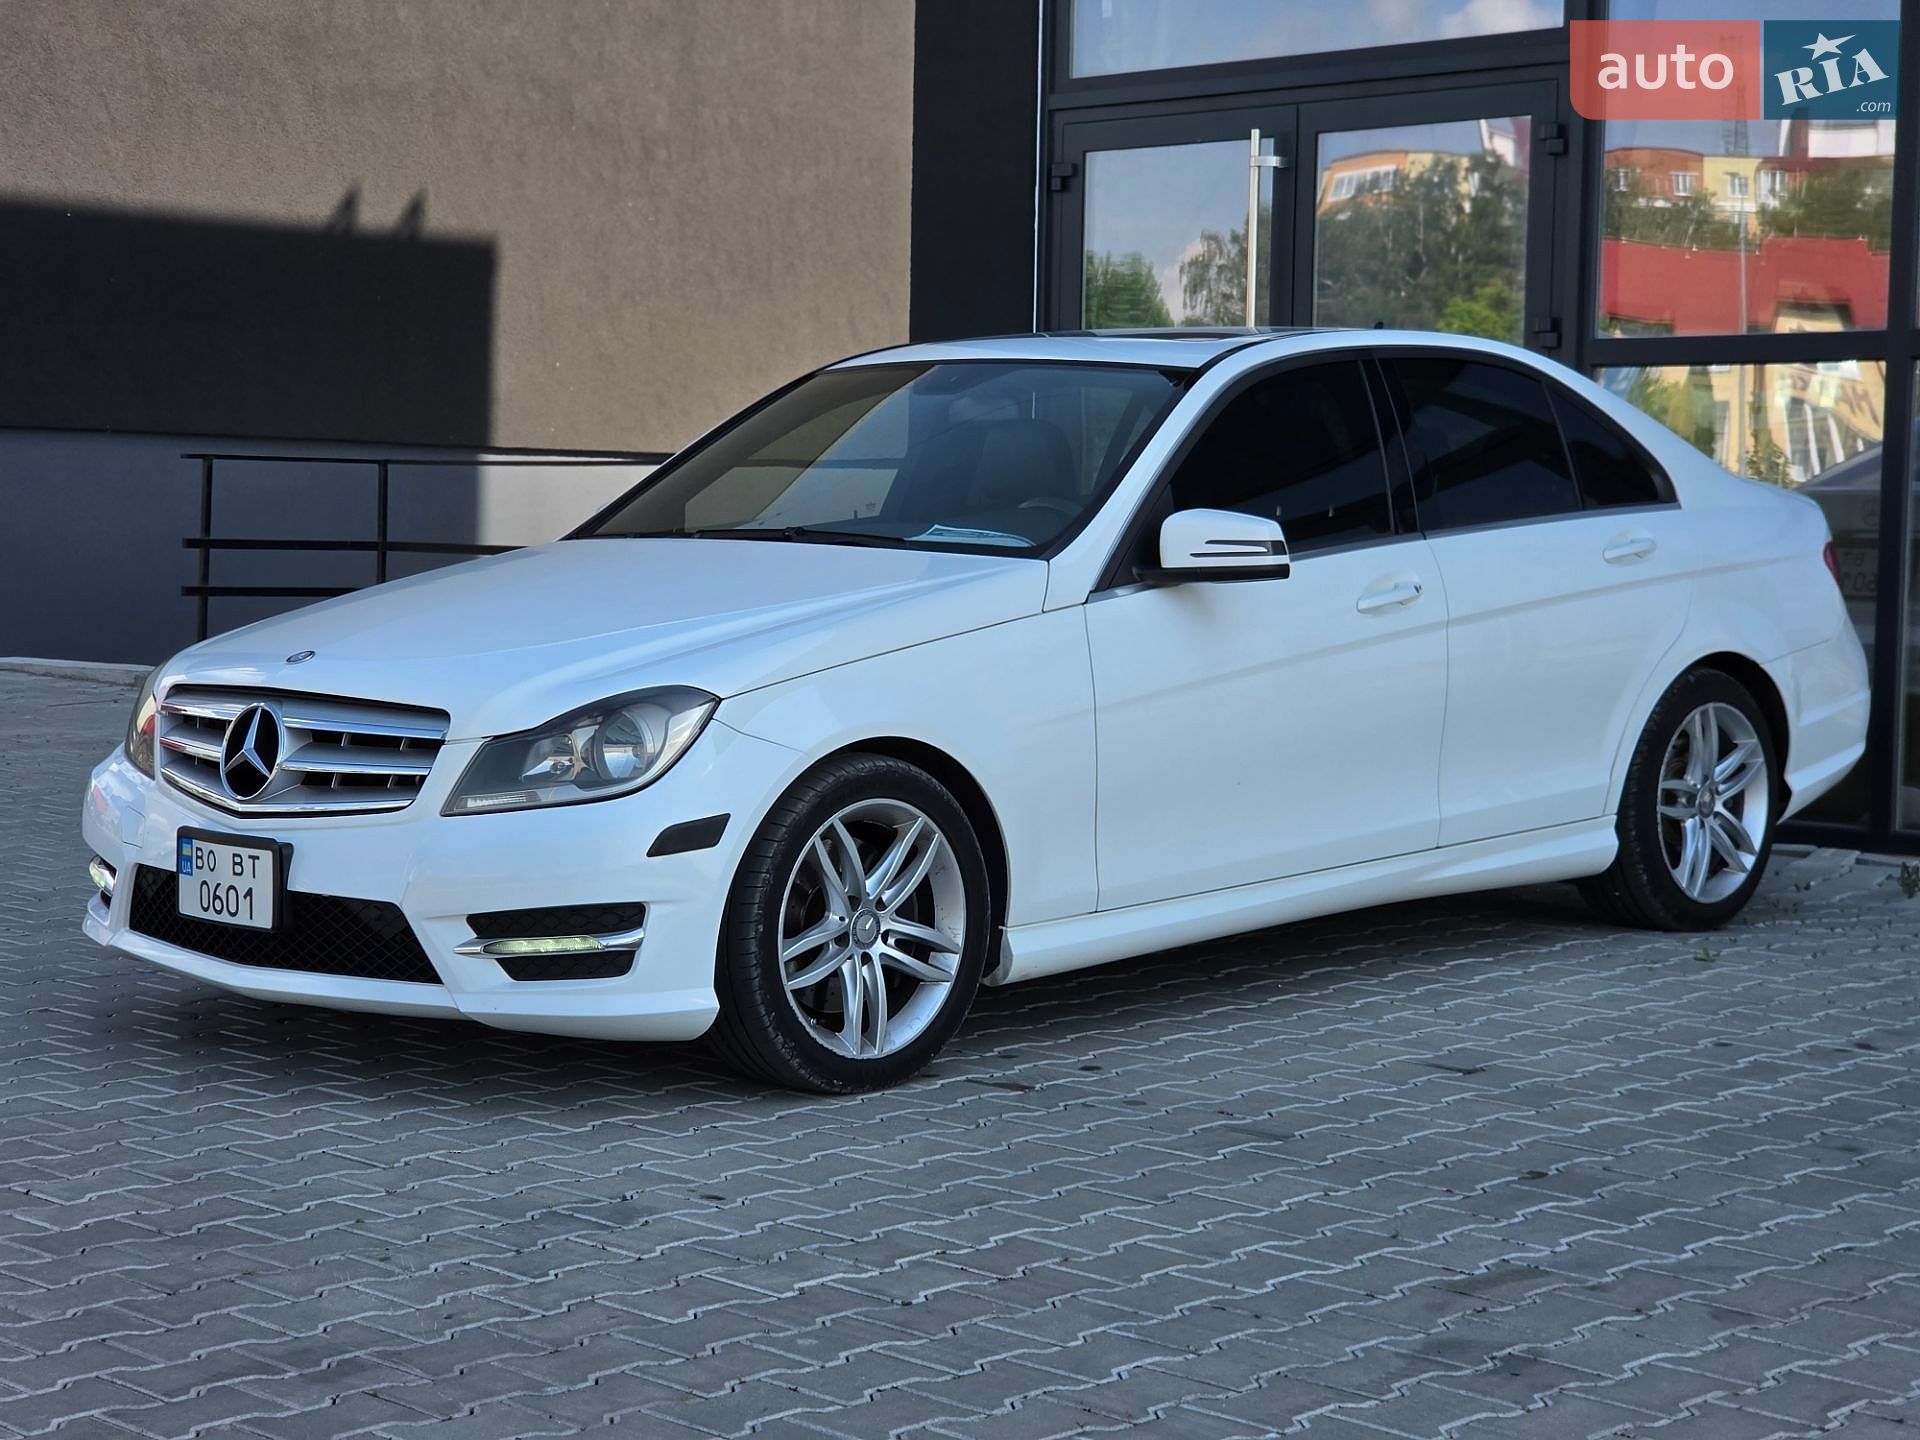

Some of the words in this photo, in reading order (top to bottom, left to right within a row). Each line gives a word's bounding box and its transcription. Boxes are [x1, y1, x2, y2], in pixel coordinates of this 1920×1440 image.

[181, 861, 192, 874] UA
[195, 846, 217, 873] BO
[232, 853, 260, 879] BT
[200, 880, 254, 921] 0601
